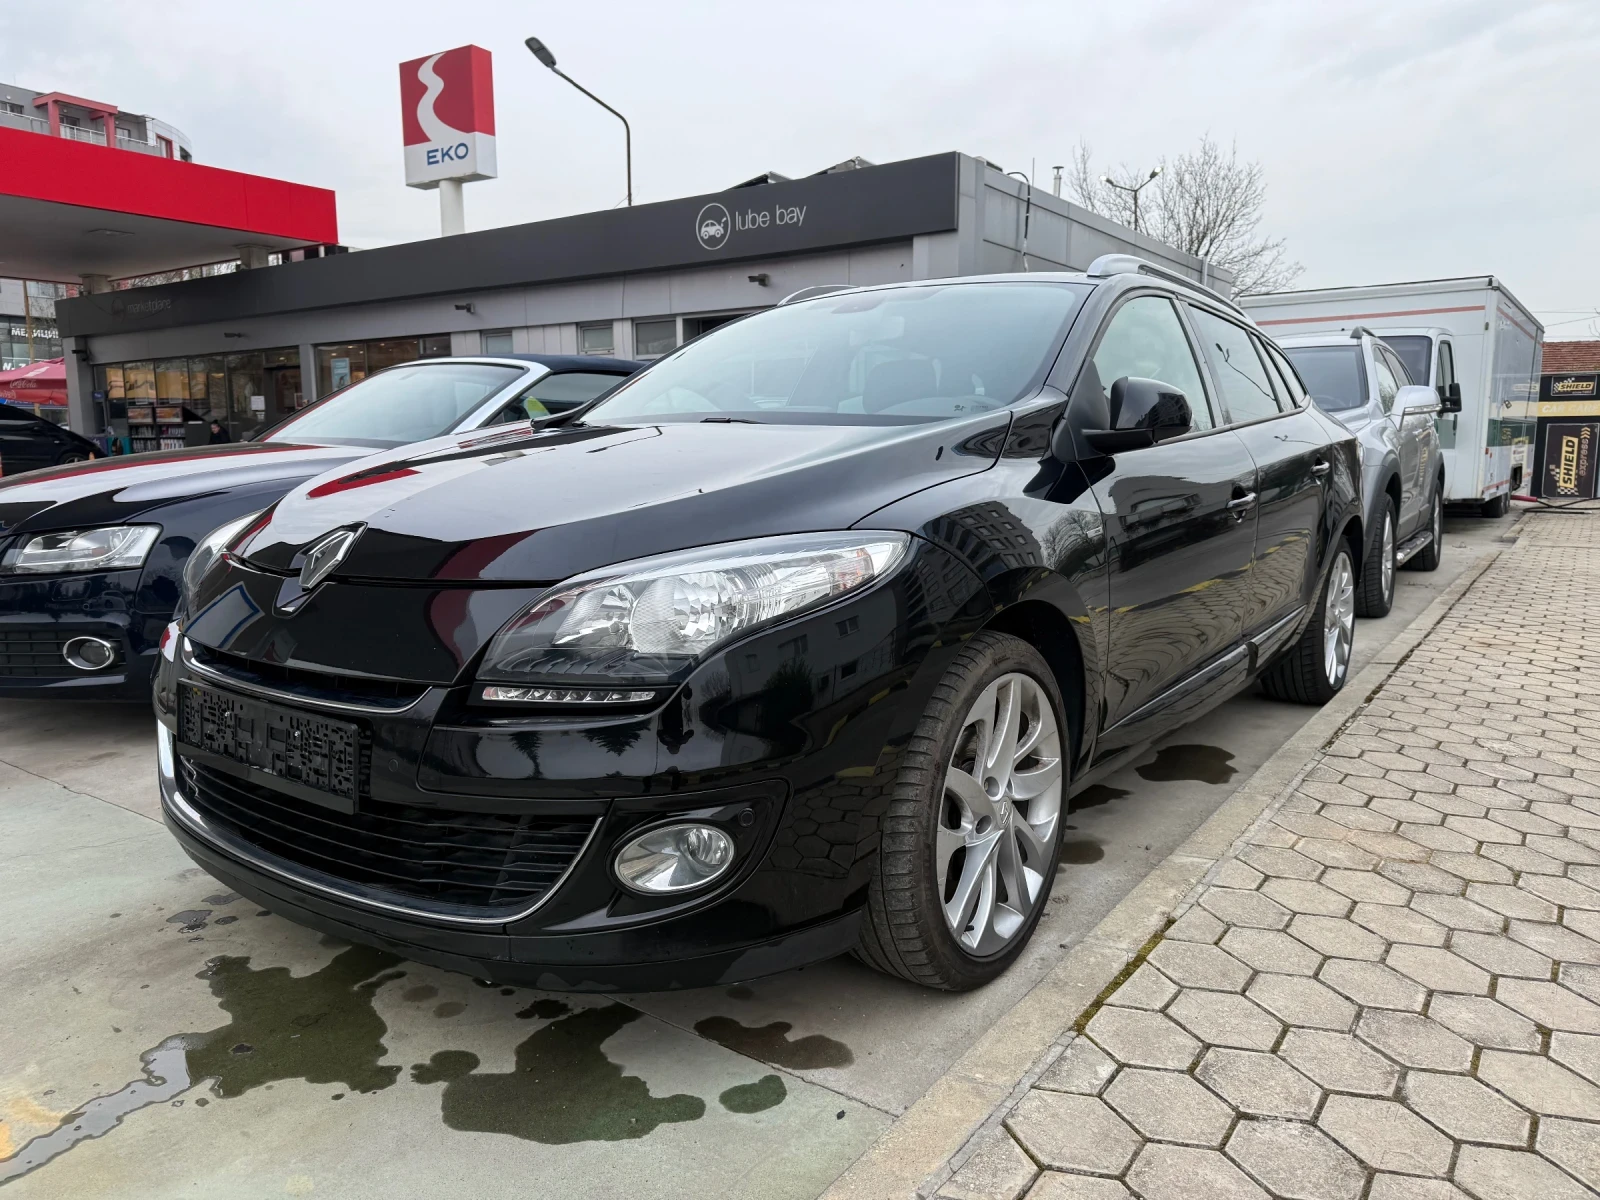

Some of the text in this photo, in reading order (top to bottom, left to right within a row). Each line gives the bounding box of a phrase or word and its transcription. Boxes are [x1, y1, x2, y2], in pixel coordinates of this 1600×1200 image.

[427, 142, 469, 166] EKO
[735, 204, 806, 231] lube bay
[127, 298, 172, 313] marketplace
[1541, 404, 1565, 414] CAR
[1562, 439, 1576, 485] SHIELD
[1578, 438, 1589, 477] express
